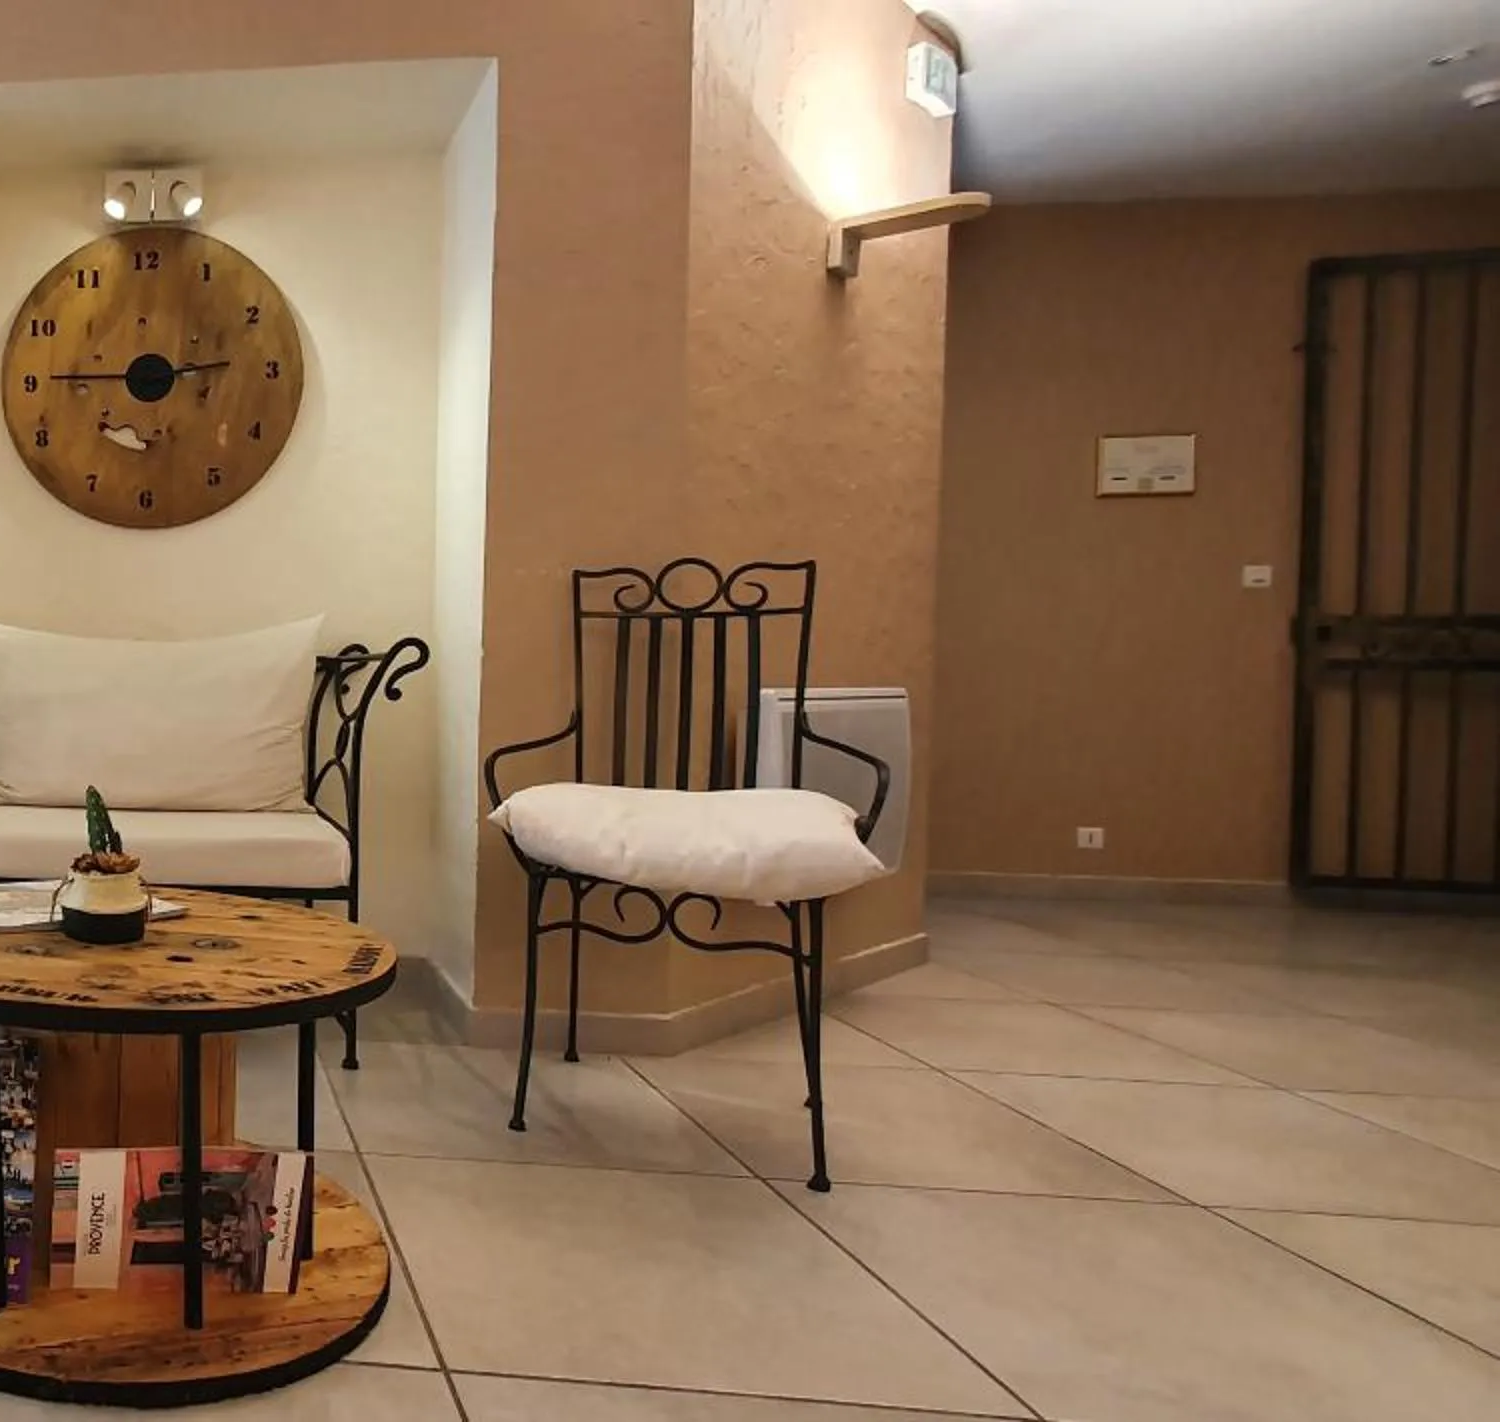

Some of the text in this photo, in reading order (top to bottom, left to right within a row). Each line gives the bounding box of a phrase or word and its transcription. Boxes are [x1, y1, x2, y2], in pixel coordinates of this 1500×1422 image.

[133, 251, 159, 271] 12
[76, 269, 100, 289] 11
[202, 263, 211, 281] 1
[246, 306, 260, 325] 2
[30, 319, 57, 337] 10
[265, 361, 280, 379] 3
[24, 375, 38, 393] 9
[35, 429, 49, 448] 8
[247, 421, 261, 440] 4
[86, 474, 98, 492] 7
[207, 468, 221, 486] 5
[139, 490, 153, 509] 6
